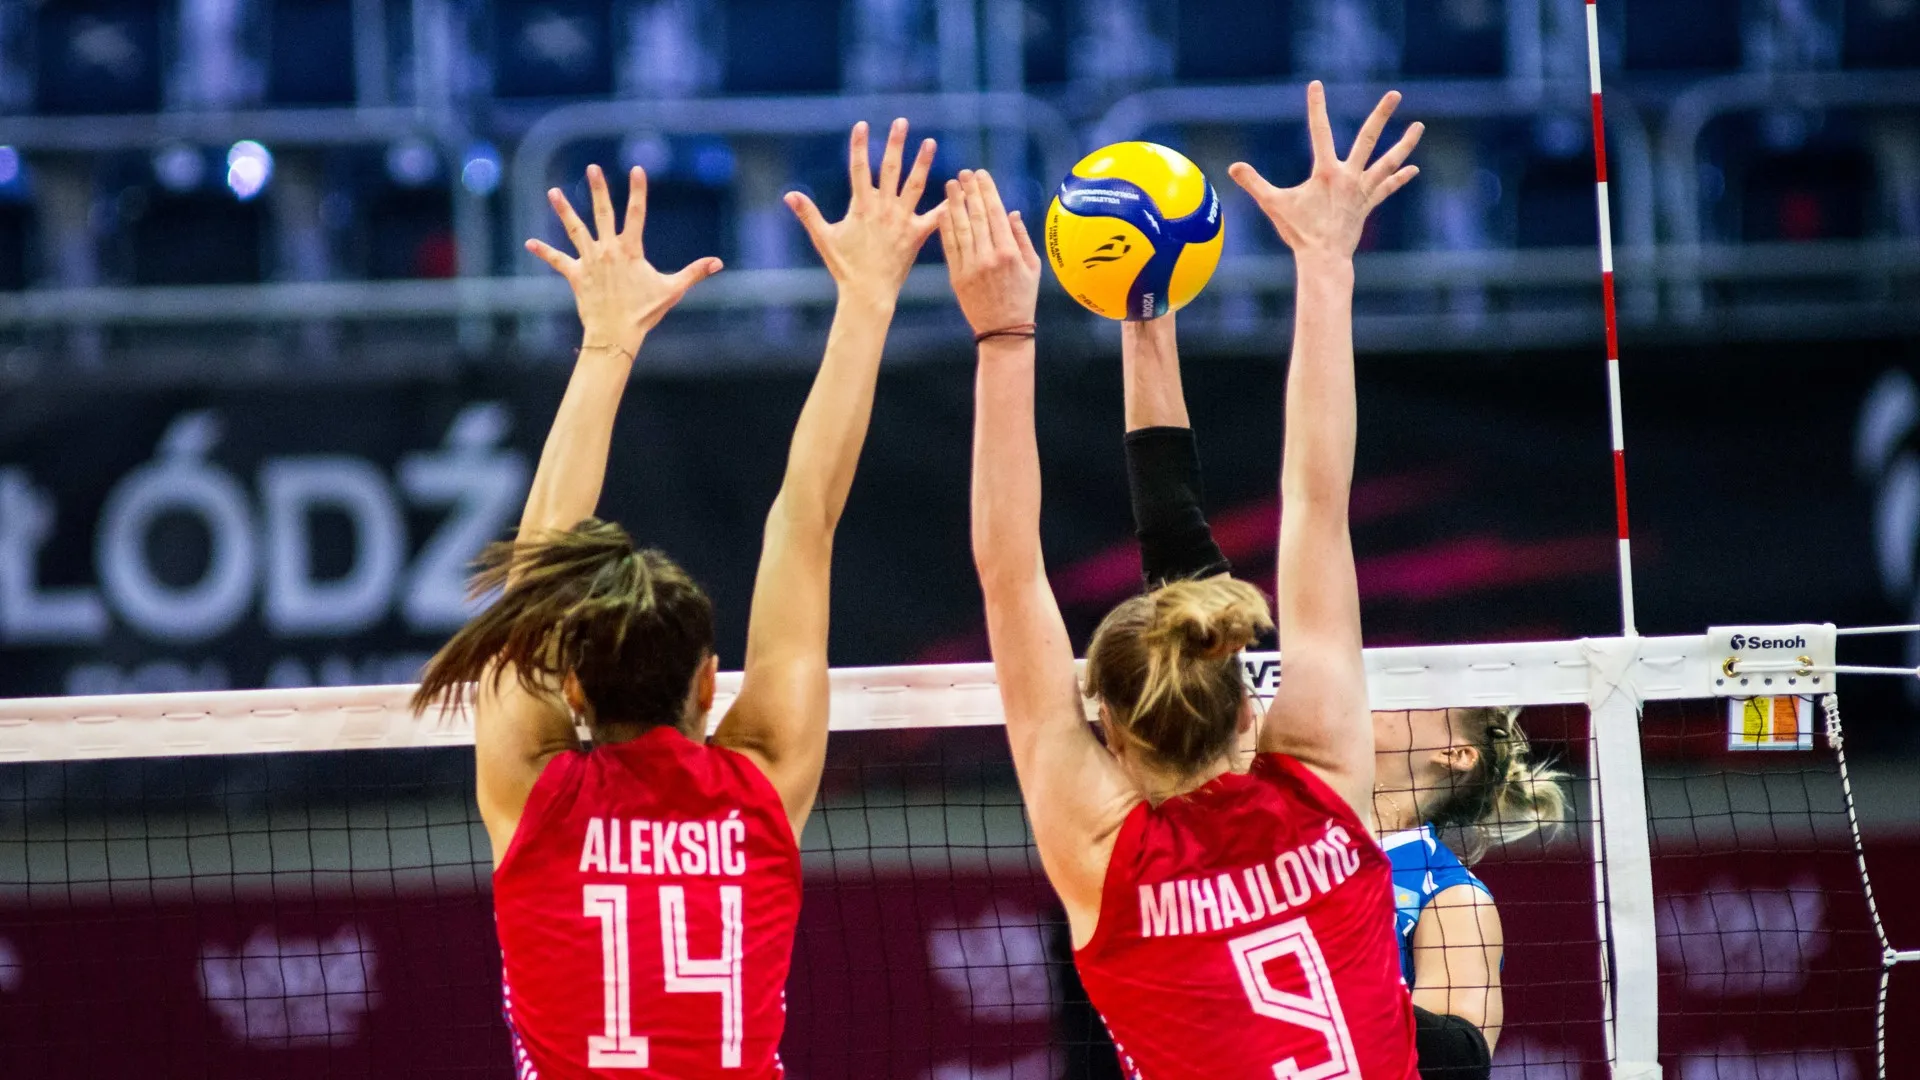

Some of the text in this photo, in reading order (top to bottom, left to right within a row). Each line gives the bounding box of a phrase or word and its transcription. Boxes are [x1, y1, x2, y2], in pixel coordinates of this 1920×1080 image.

[1748, 635, 1806, 650] Senoh
[579, 810, 746, 876] ALEKSIĆ
[1138, 818, 1361, 938] MIHAJLOVIĆ
[583, 884, 743, 1069] 14
[1228, 916, 1362, 1080] 9
